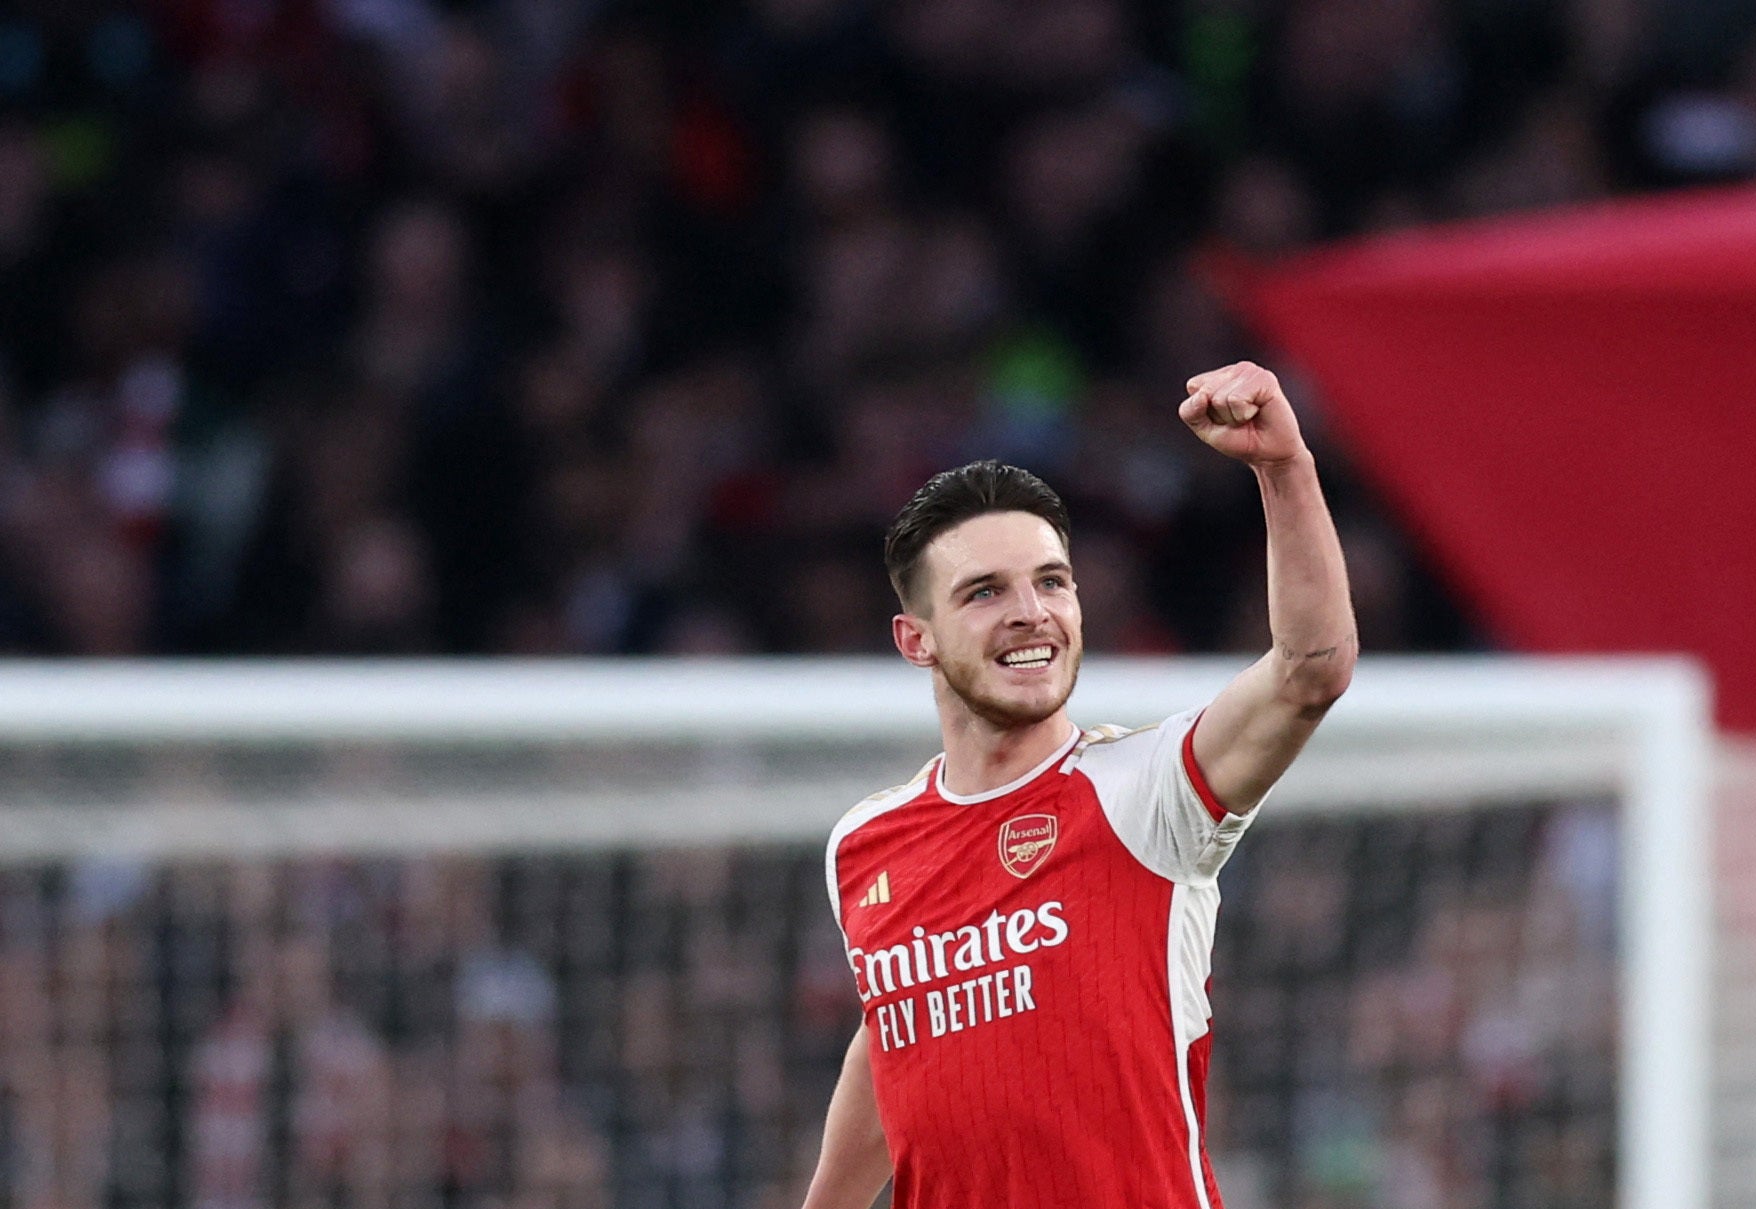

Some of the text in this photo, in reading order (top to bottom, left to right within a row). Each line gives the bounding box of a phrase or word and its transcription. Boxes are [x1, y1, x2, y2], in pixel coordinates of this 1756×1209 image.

[1008, 824, 1050, 841] Arsenal
[876, 964, 1036, 1052] FLY BETTER
